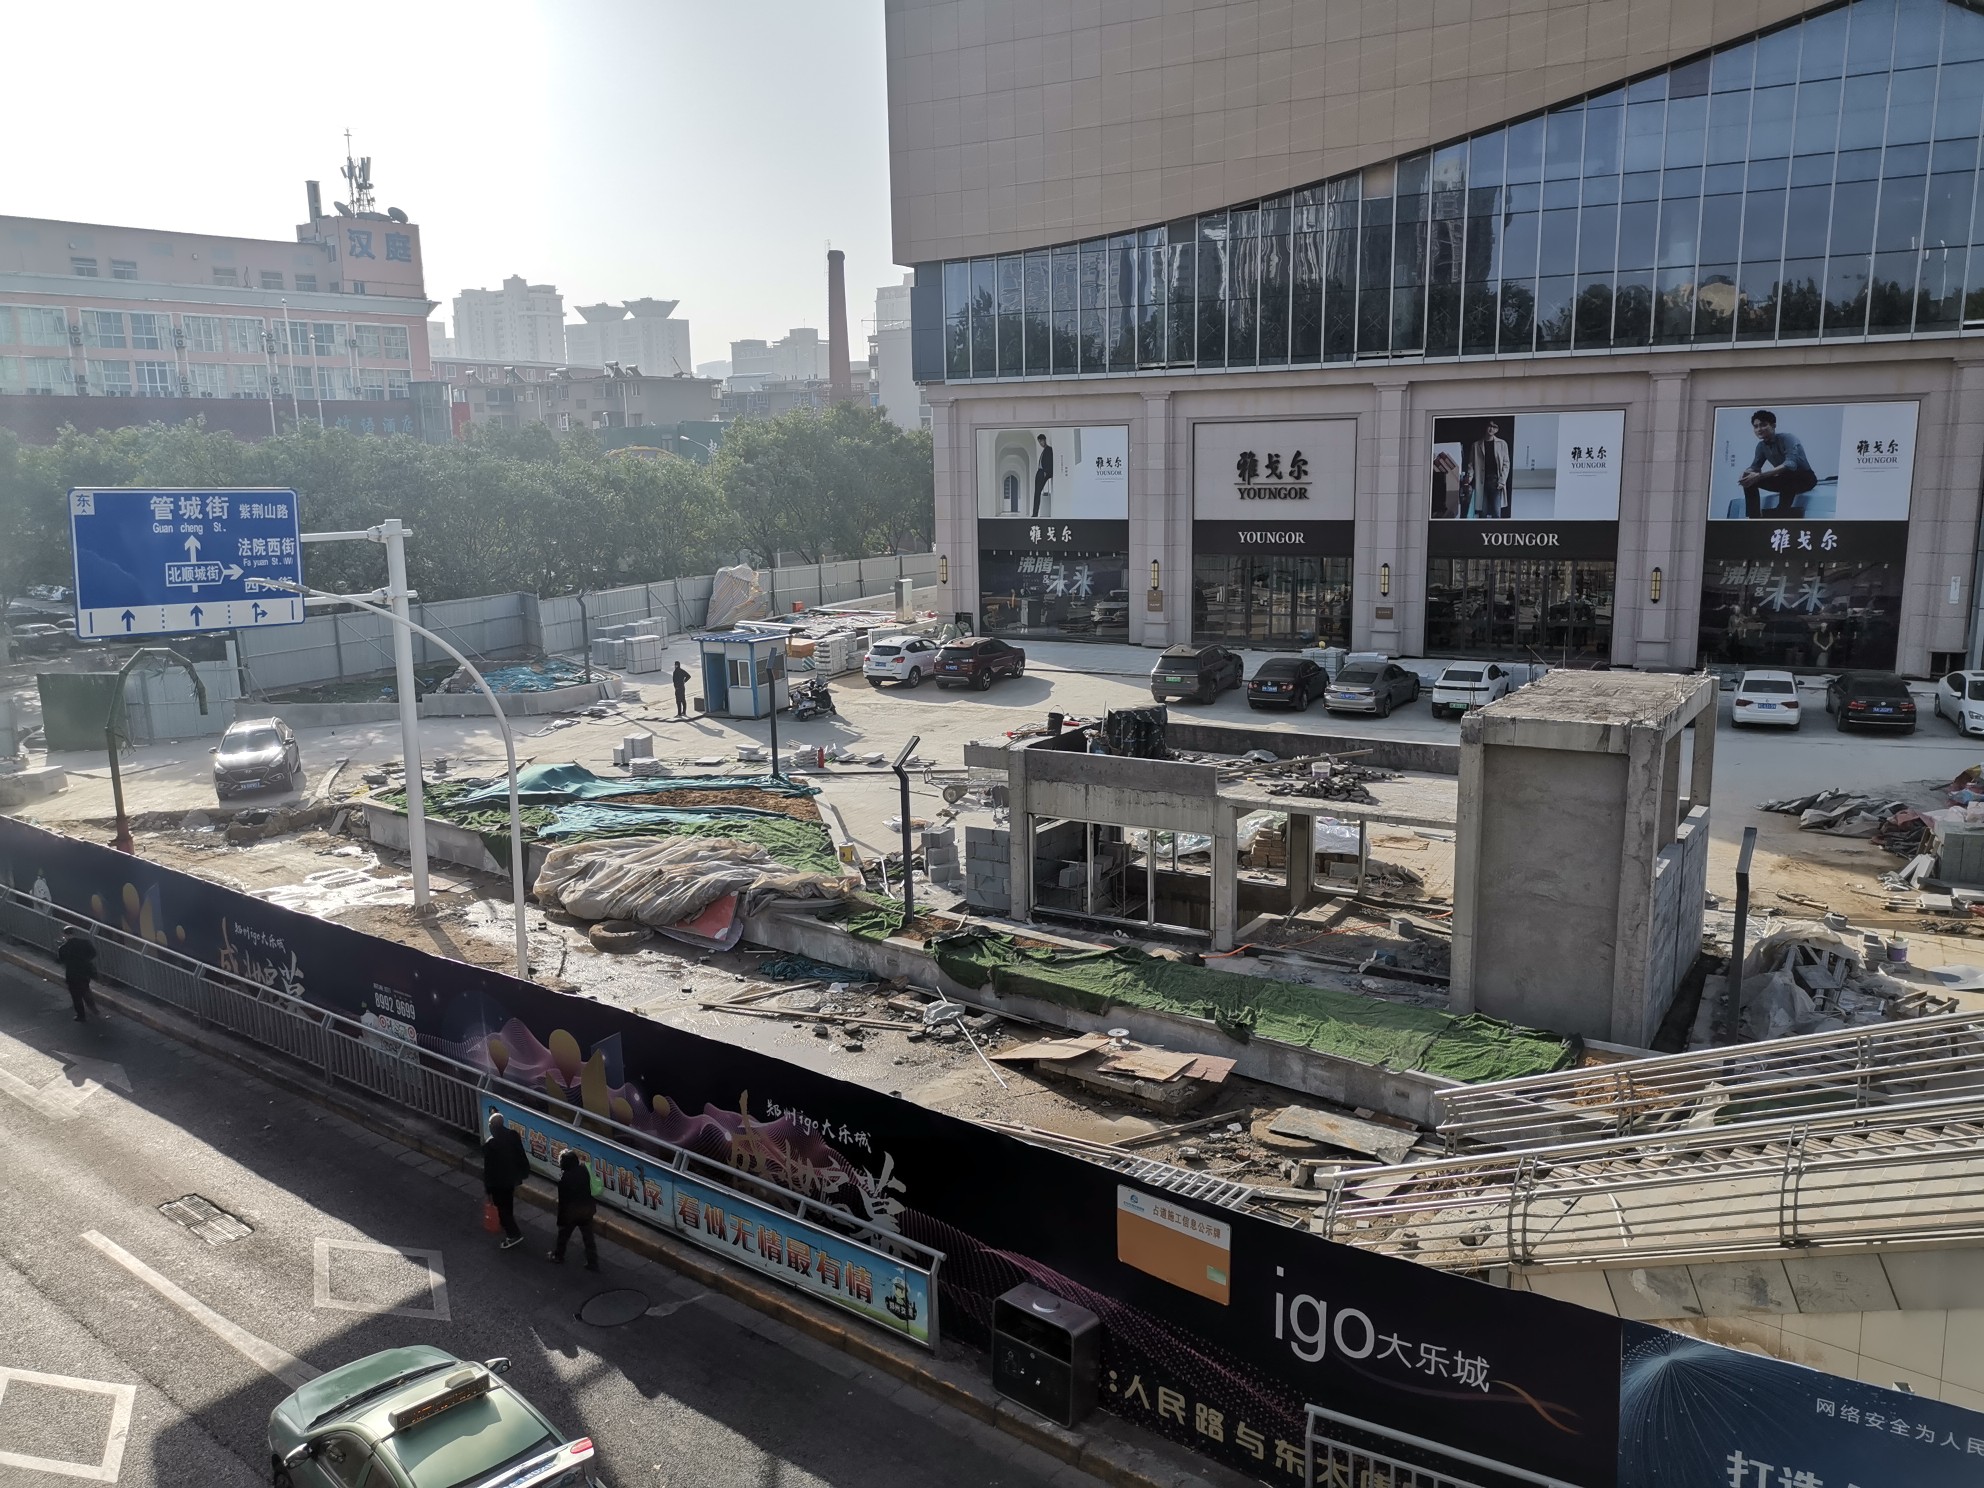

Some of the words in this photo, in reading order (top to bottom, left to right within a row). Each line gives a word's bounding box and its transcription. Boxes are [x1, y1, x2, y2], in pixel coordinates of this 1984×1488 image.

[347, 228, 411, 263] 汉庭
[1571, 446, 1607, 461] 雅戈尔
[1856, 439, 1899, 456] 雅戈尔
[1096, 457, 1122, 469] 雅戈尔
[1236, 450, 1309, 485] 雅戈尔
[1856, 456, 1898, 464] YOUNGOR
[76, 494, 91, 508] 东
[1237, 487, 1310, 500] YOUNGOR
[150, 496, 229, 520] 管城街
[239, 504, 288, 519] 紫荆山路
[152, 522, 173, 533] Guan
[180, 523, 203, 535] cheng
[213, 522, 227, 532] St.
[1029, 525, 1072, 544] 雅戈尔
[1238, 532, 1305, 544] YOUNGOR
[1481, 533, 1560, 546] YOUNGOR
[1770, 528, 1838, 553] 雅戈尔
[238, 538, 295, 557] 法院西街
[243, 559, 251, 567] Fa
[253, 560, 269, 568] yuan
[1018, 556, 1053, 574] 沸腾
[169, 566, 219, 583] 北顺城街
[1720, 566, 1771, 585] 沸腾
[375, 992, 394, 1013] 8992
[396, 998, 416, 1021] 9699
[766, 1099, 872, 1153] 郑州igo大乐城
[1153, 1204, 1221, 1240] 占道施工信息公示牌
[677, 1191, 873, 1305] 看似无情最有情
[1816, 1398, 1984, 1457] 网络安全为人民
[1727, 1450, 1862, 1488] 打造
